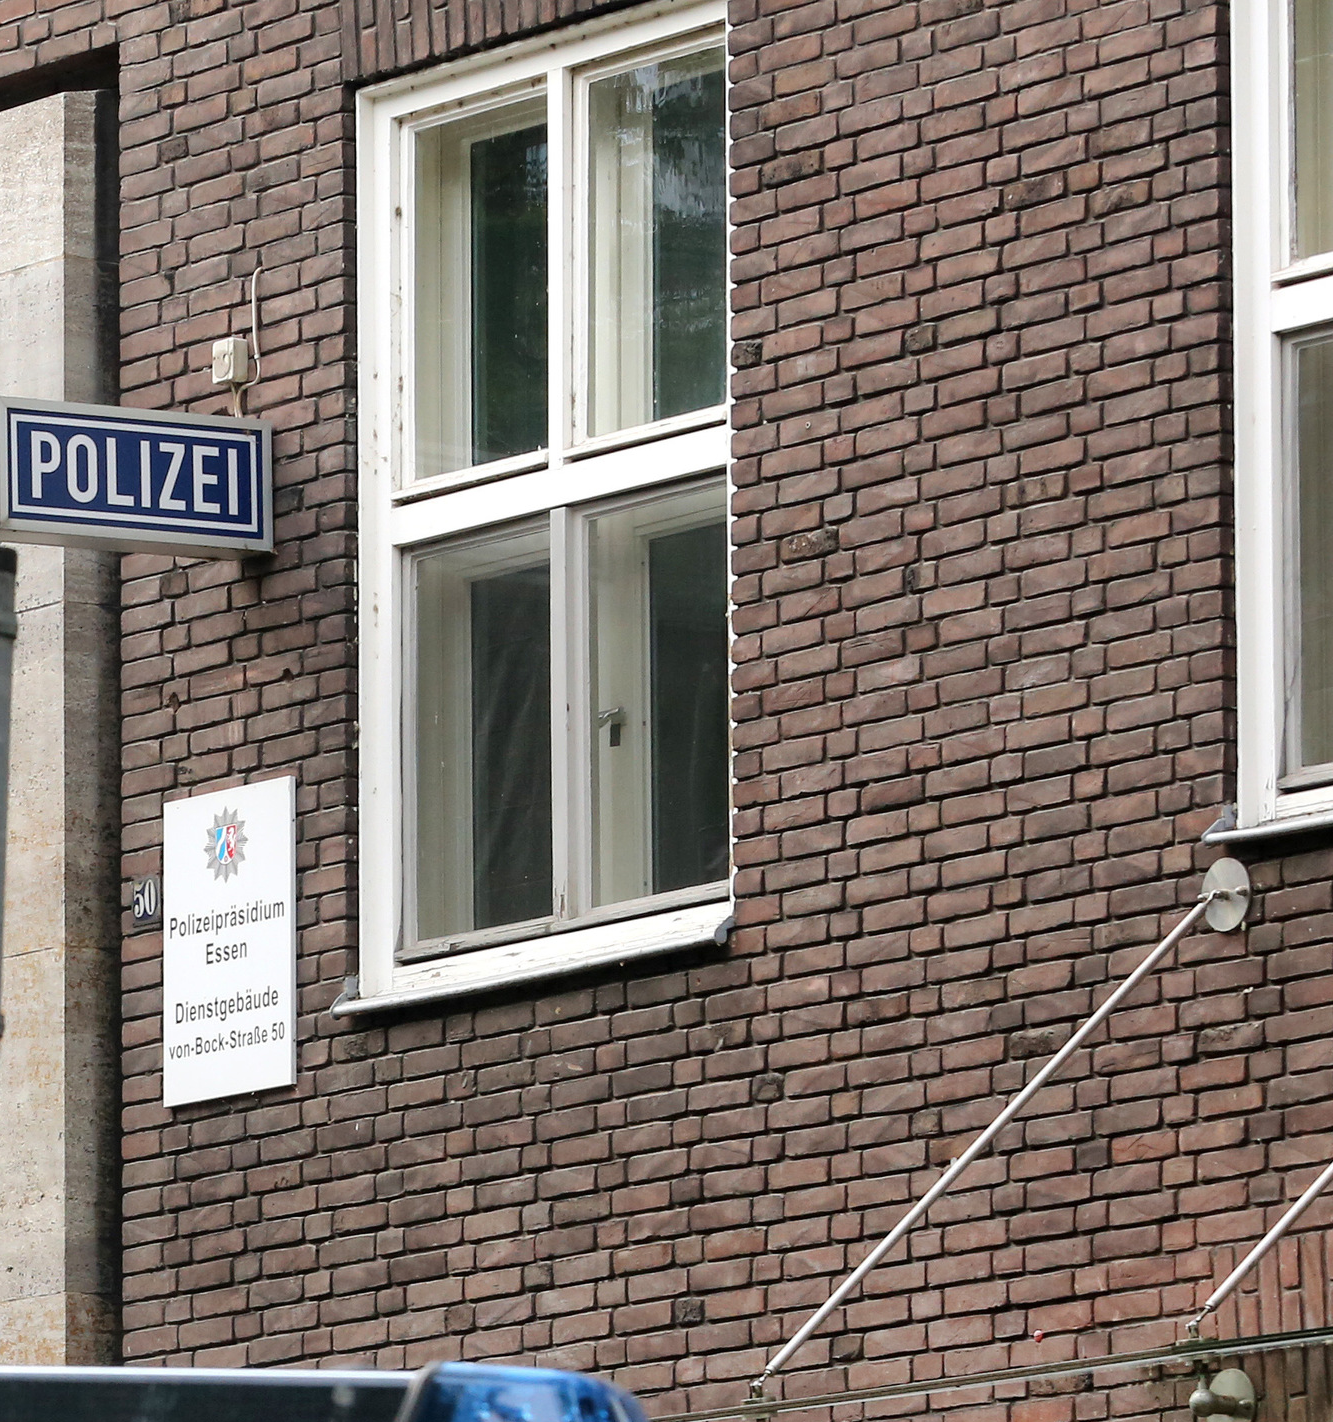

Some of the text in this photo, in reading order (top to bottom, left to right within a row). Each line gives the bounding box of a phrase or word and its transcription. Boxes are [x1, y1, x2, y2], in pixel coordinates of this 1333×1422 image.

[30, 429, 240, 516] POLIZEI
[134, 878, 157, 919] 50
[169, 899, 285, 939] Polizeipräsidium
[205, 941, 248, 965] Essen
[175, 985, 279, 1024] Dienstgebäude
[169, 1021, 286, 1060] von-Bock-Straße 50
